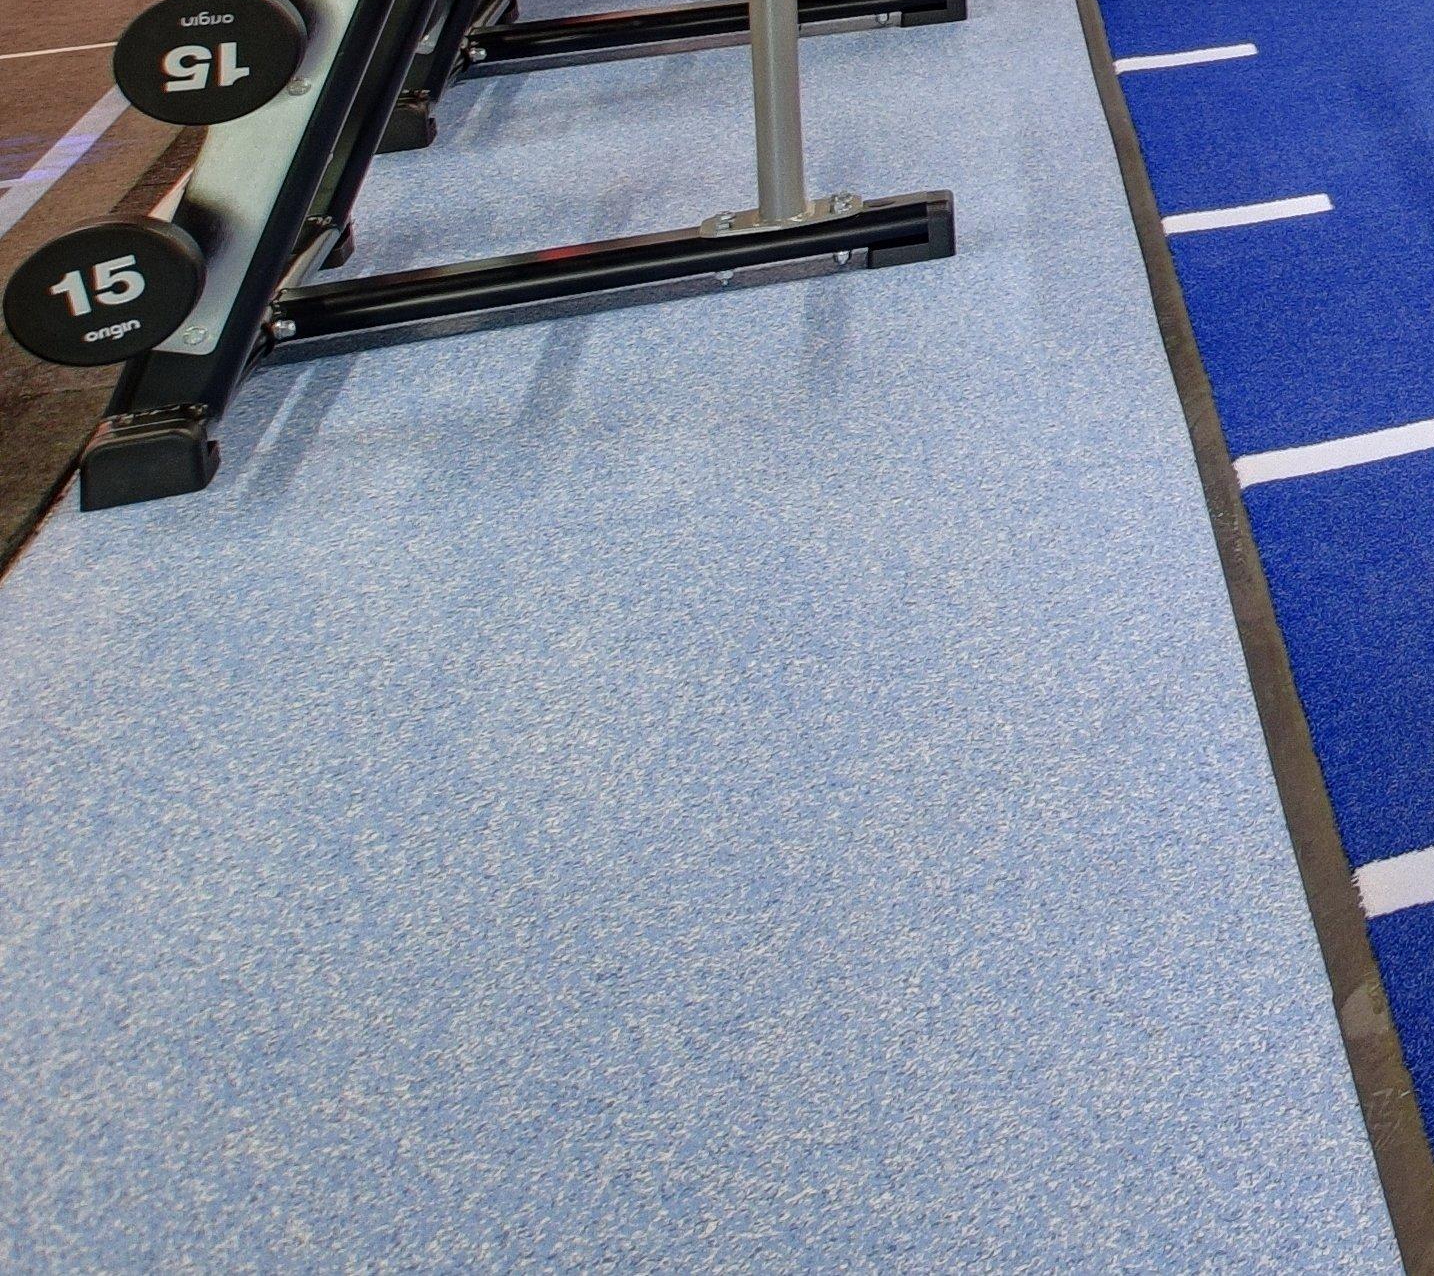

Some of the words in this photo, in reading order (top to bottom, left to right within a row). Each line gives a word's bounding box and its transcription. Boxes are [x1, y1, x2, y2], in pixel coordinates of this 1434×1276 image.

[180, 11, 234, 28] origin
[163, 42, 251, 93] 15
[50, 254, 147, 317] 15
[84, 319, 142, 343] origin
